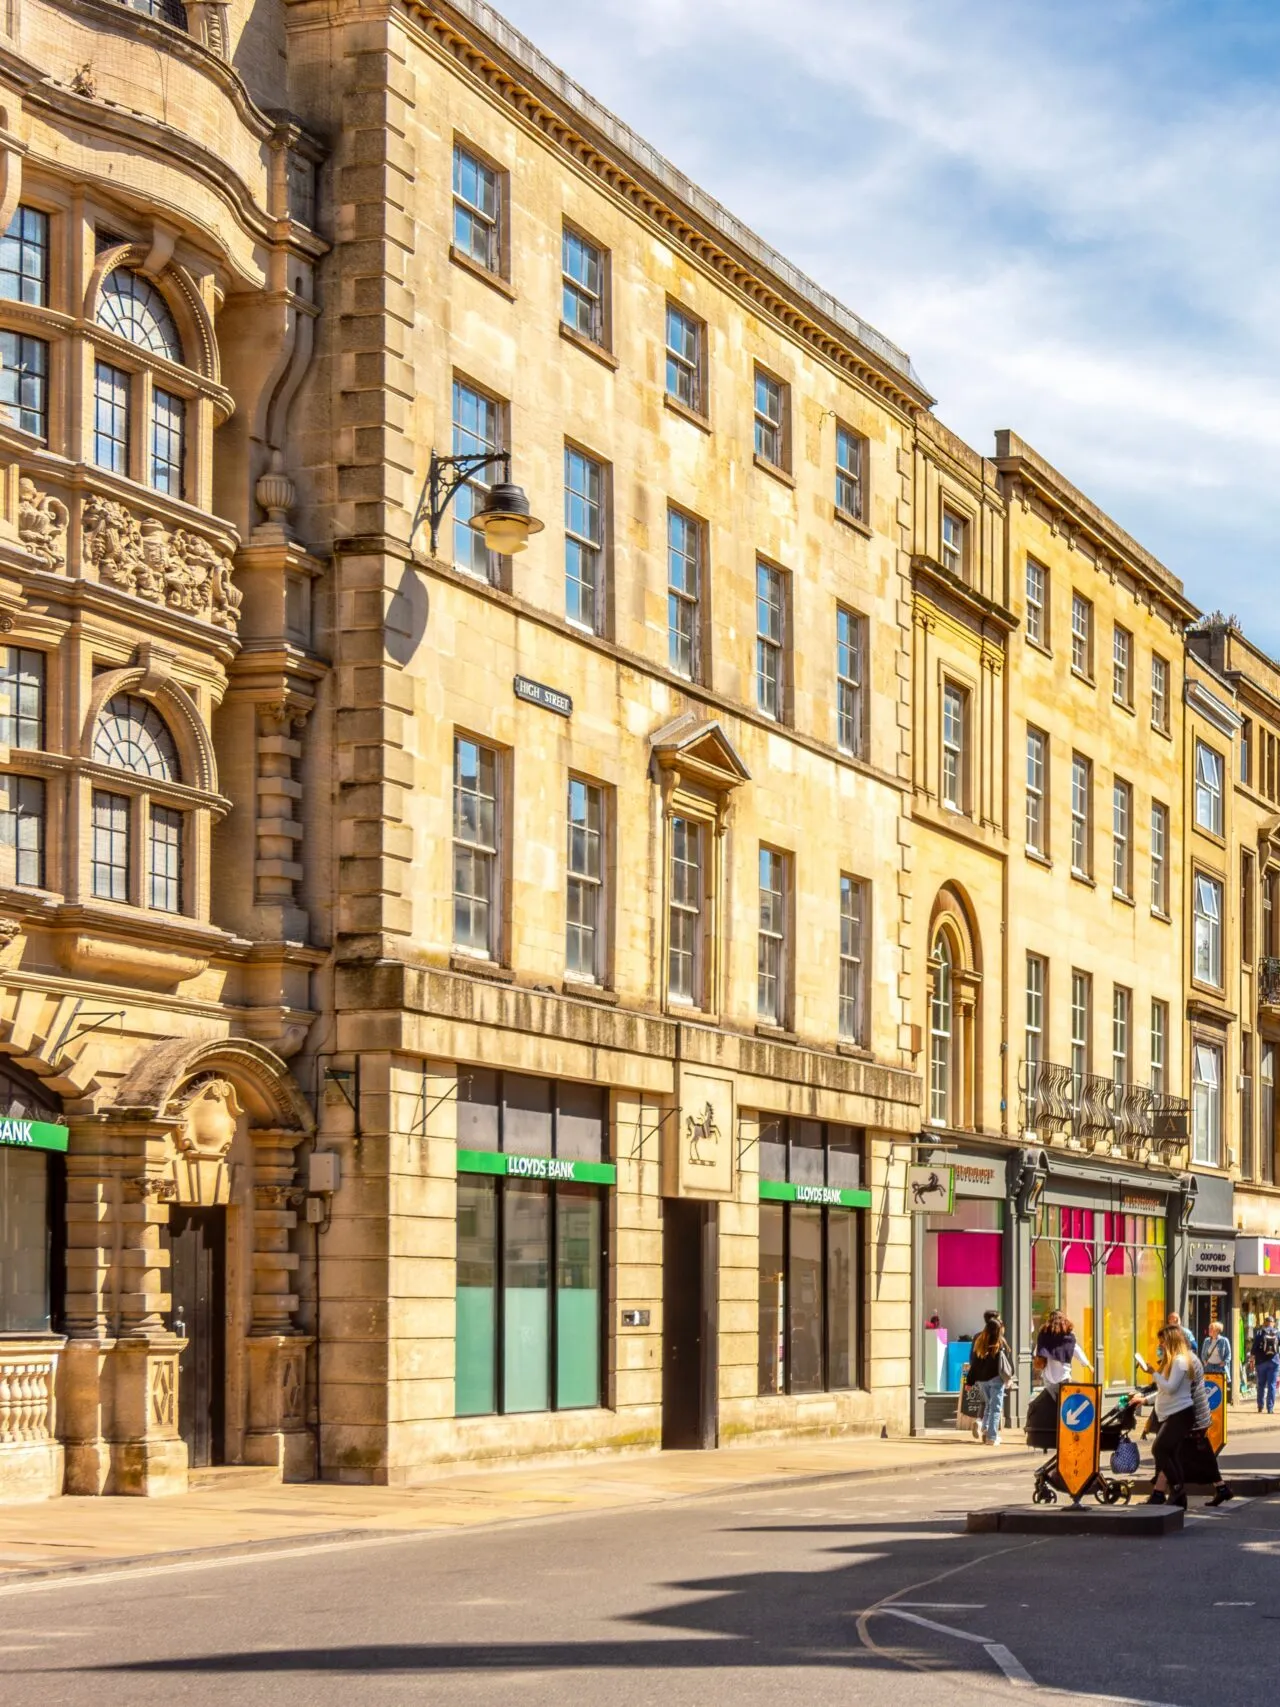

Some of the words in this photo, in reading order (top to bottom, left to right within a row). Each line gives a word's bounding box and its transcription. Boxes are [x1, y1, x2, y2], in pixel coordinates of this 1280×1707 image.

[519, 680, 540, 699] HIGH
[544, 690, 569, 710] STREET
[0, 1120, 33, 1143] ANK
[508, 1156, 547, 1176] LLOYDS
[548, 1160, 575, 1179] BANK
[797, 1185, 823, 1202] LLOYDS
[823, 1188, 842, 1204] BANK
[1200, 1252, 1227, 1261] OXFORD
[1195, 1263, 1231, 1272] SOUVENIRS
